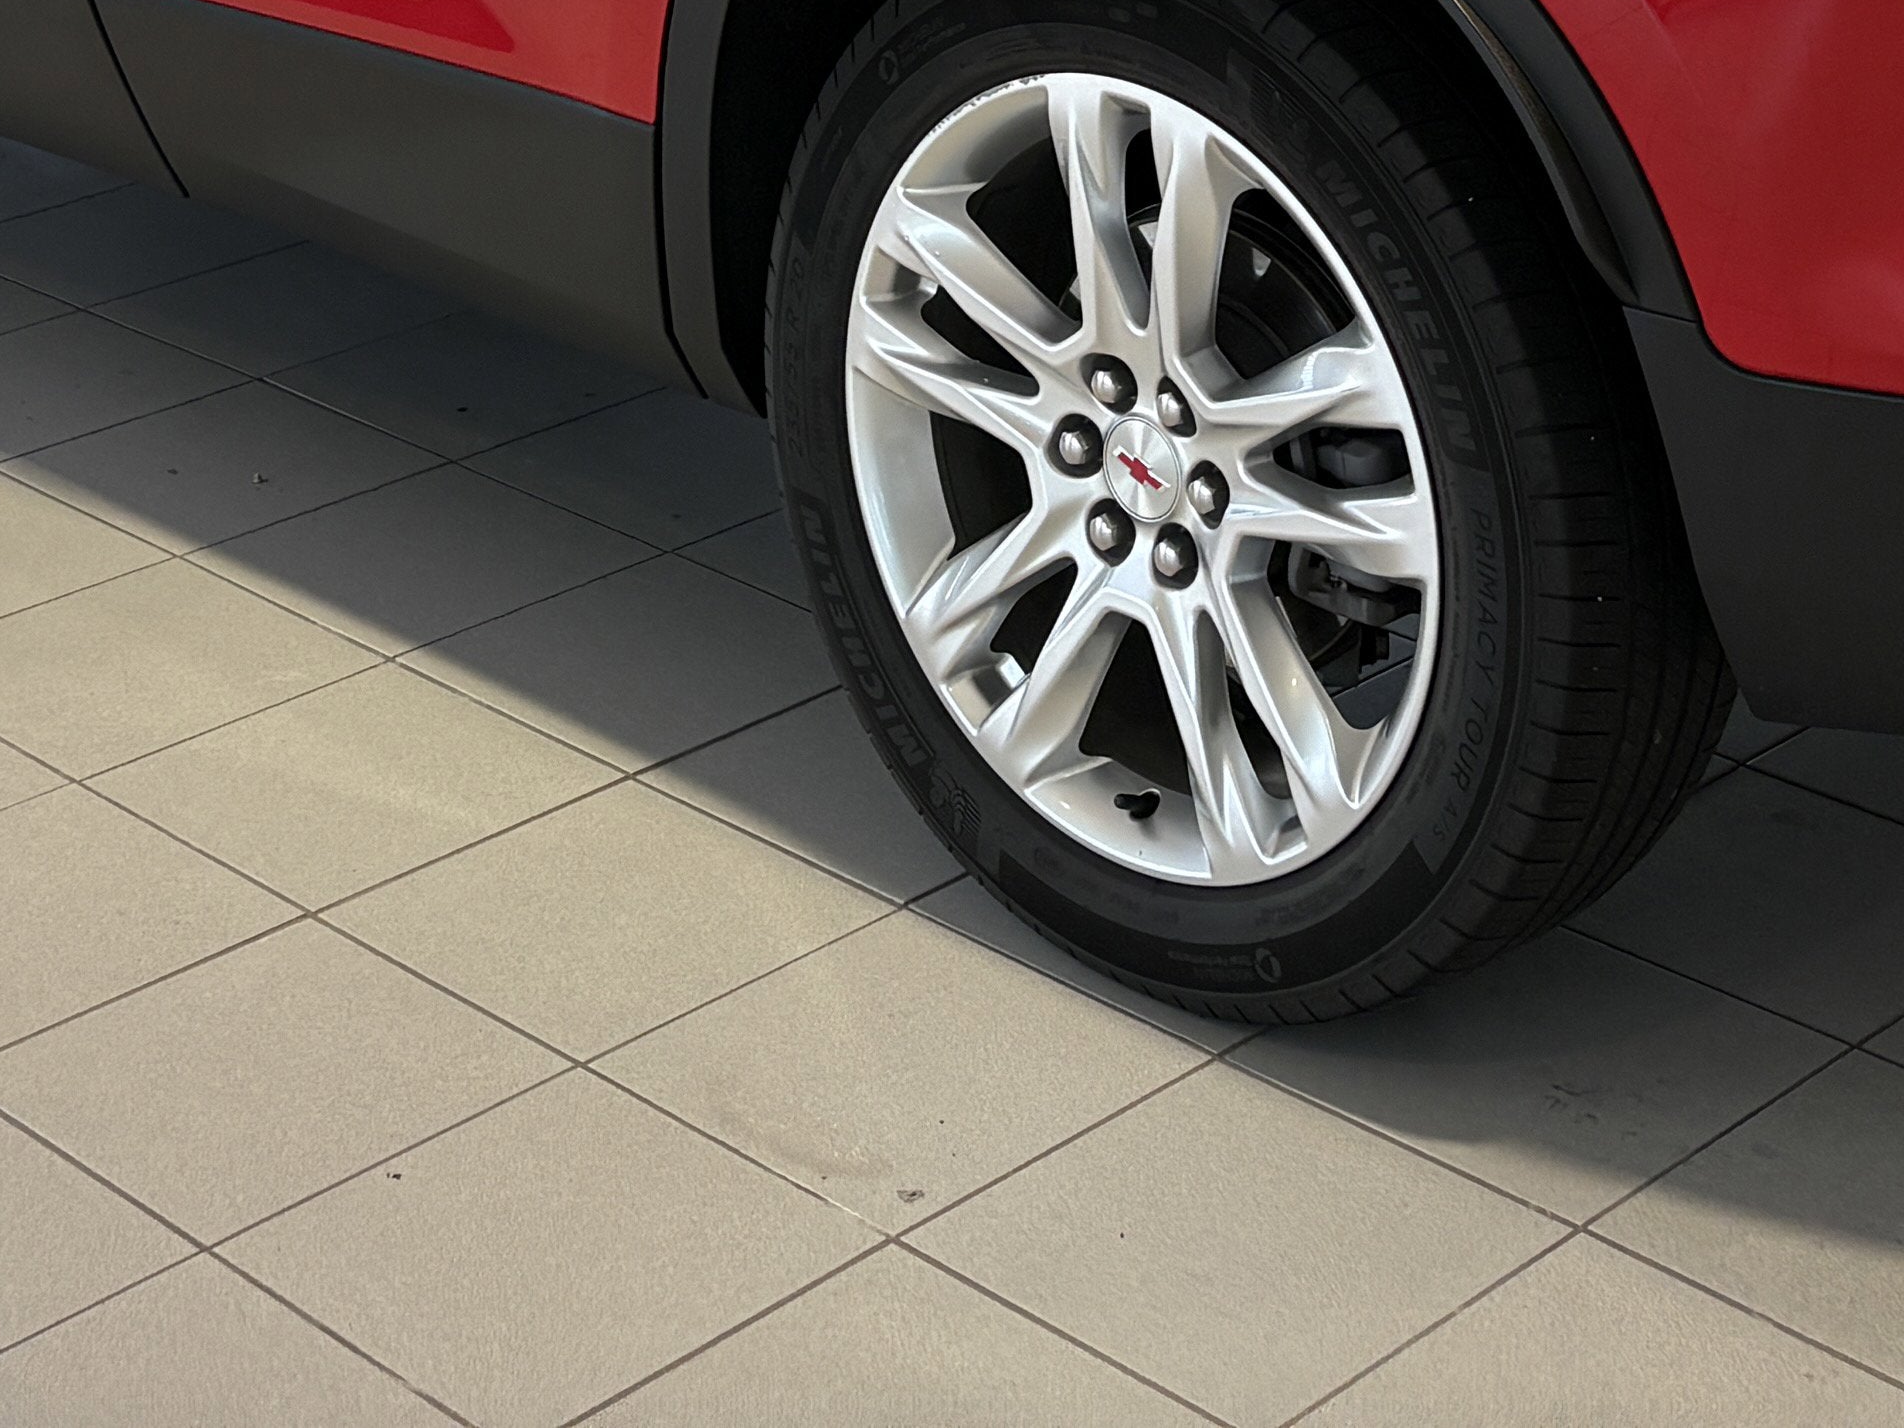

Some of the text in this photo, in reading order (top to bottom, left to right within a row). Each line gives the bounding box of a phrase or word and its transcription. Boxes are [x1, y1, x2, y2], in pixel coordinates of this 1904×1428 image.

[1315, 160, 1477, 450] MICHELIN
[799, 503, 928, 769] MICHELIN
[1470, 507, 1499, 688] PRIMACY
[1450, 696, 1489, 793] TOUR
